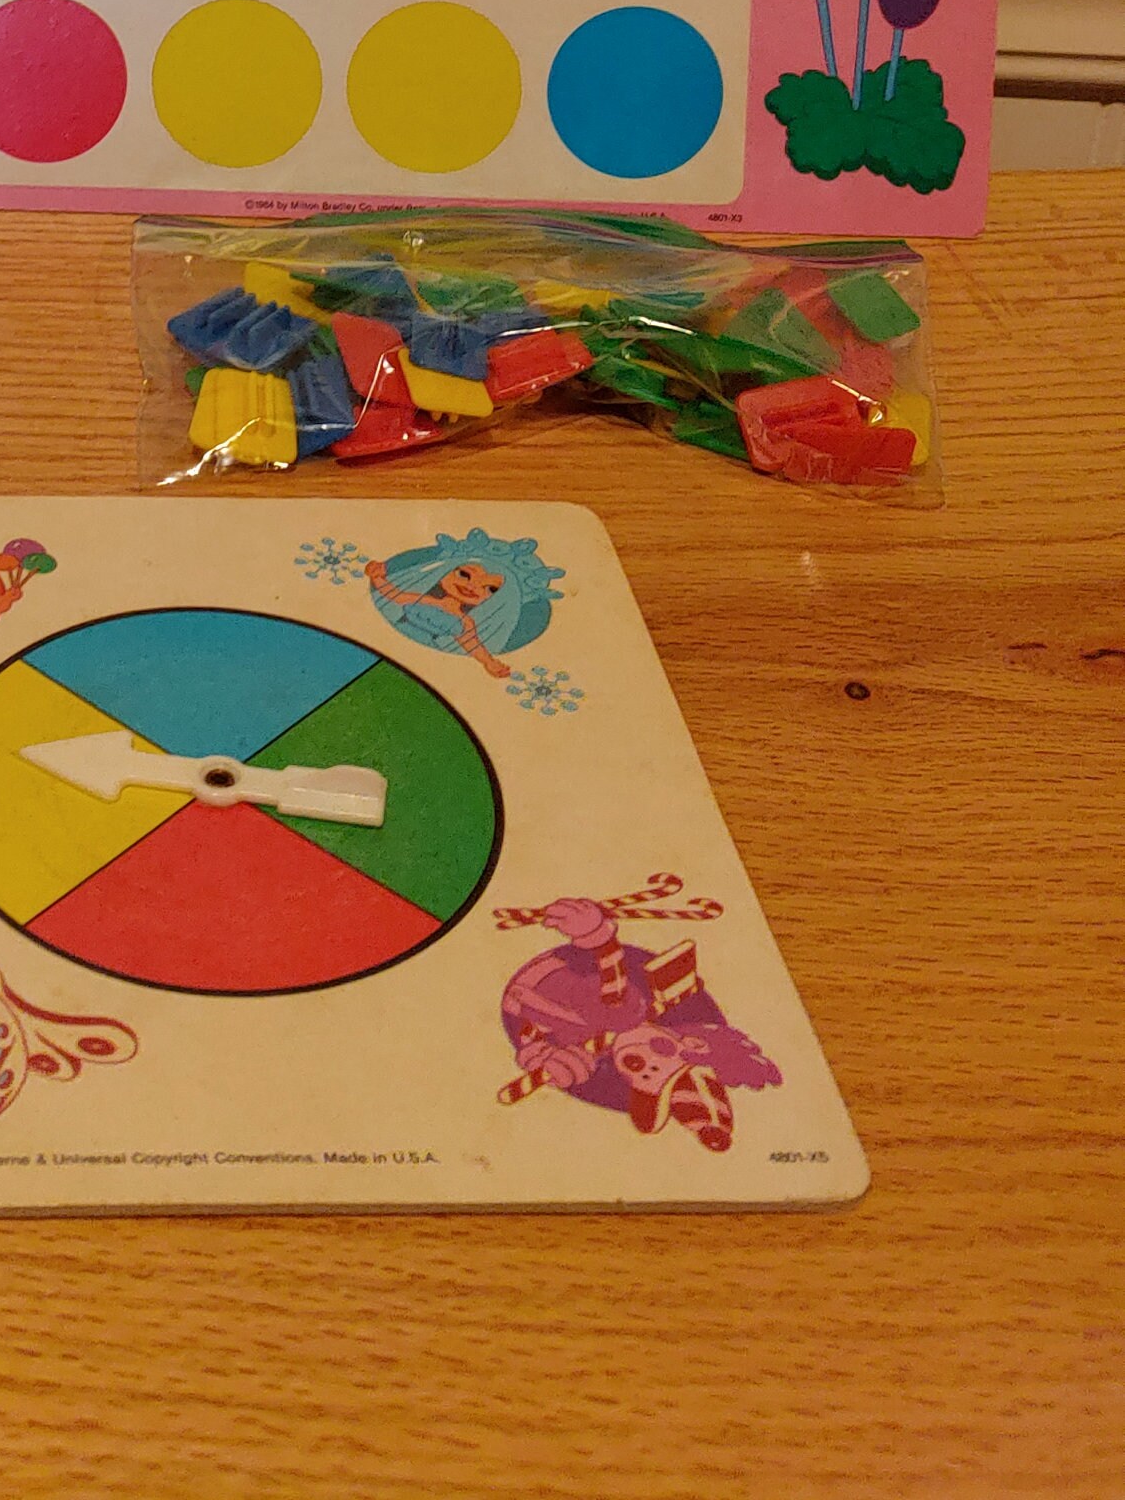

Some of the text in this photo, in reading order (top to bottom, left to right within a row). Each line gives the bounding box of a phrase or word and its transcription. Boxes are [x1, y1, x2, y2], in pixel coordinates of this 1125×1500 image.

[276, 201, 288, 211] by
[36, 1153, 47, 1165] &
[53, 1153, 126, 1165] Universal
[131, 1151, 209, 1168] Copyright
[323, 1152, 367, 1164] Made
[373, 1152, 387, 1164] in
